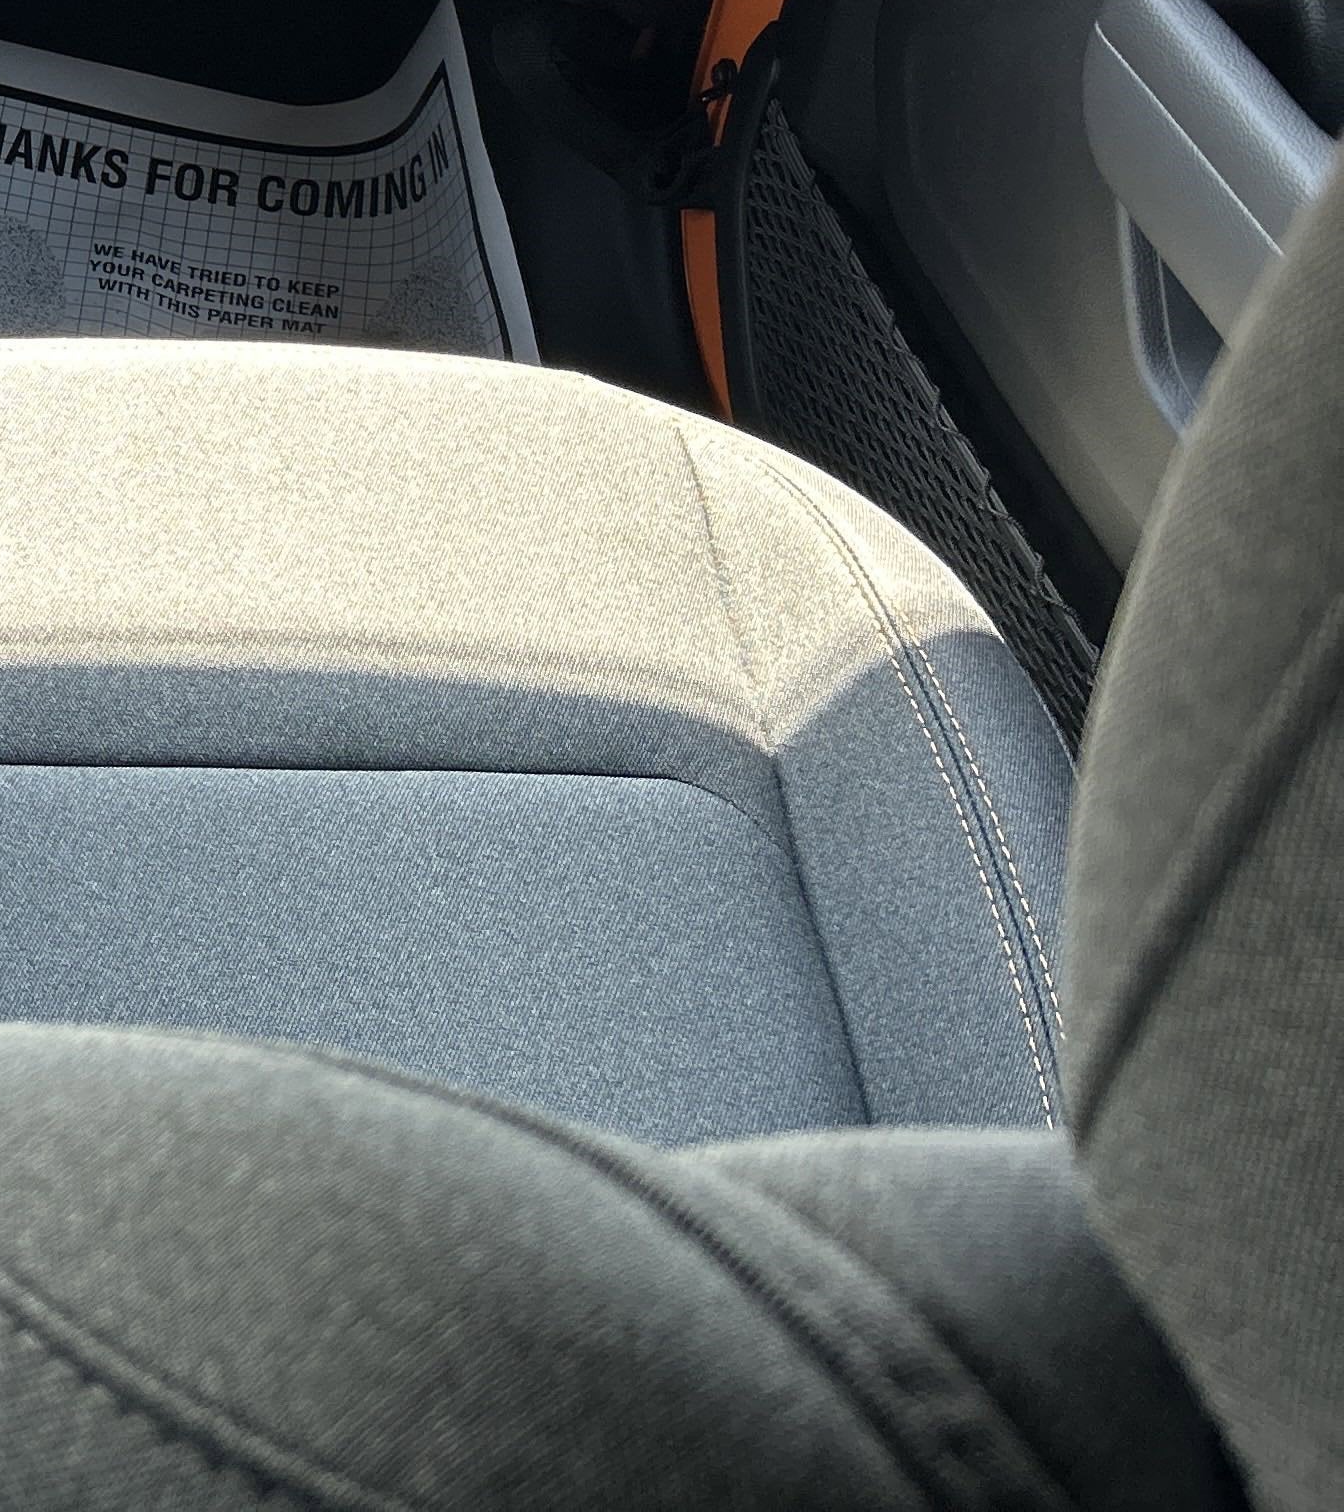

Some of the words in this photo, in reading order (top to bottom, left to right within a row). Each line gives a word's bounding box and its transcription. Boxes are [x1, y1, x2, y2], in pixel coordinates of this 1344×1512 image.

[145, 157, 239, 207] FOR
[257, 154, 427, 219] COMING
[428, 123, 449, 185] IN
[89, 259, 144, 281] YOUR
[151, 273, 265, 310] CARPETING
[272, 298, 339, 320] CLEAN
[94, 243, 125, 259] WE
[131, 249, 181, 276] HAVE
[187, 265, 247, 288] TRIED
[254, 275, 280, 292] TO
[287, 279, 340, 299] KEEP
[98, 277, 150, 302] WITH
[156, 293, 200, 320] THIS
[207, 308, 273, 329] PAPER
[281, 319, 328, 334] MAT
